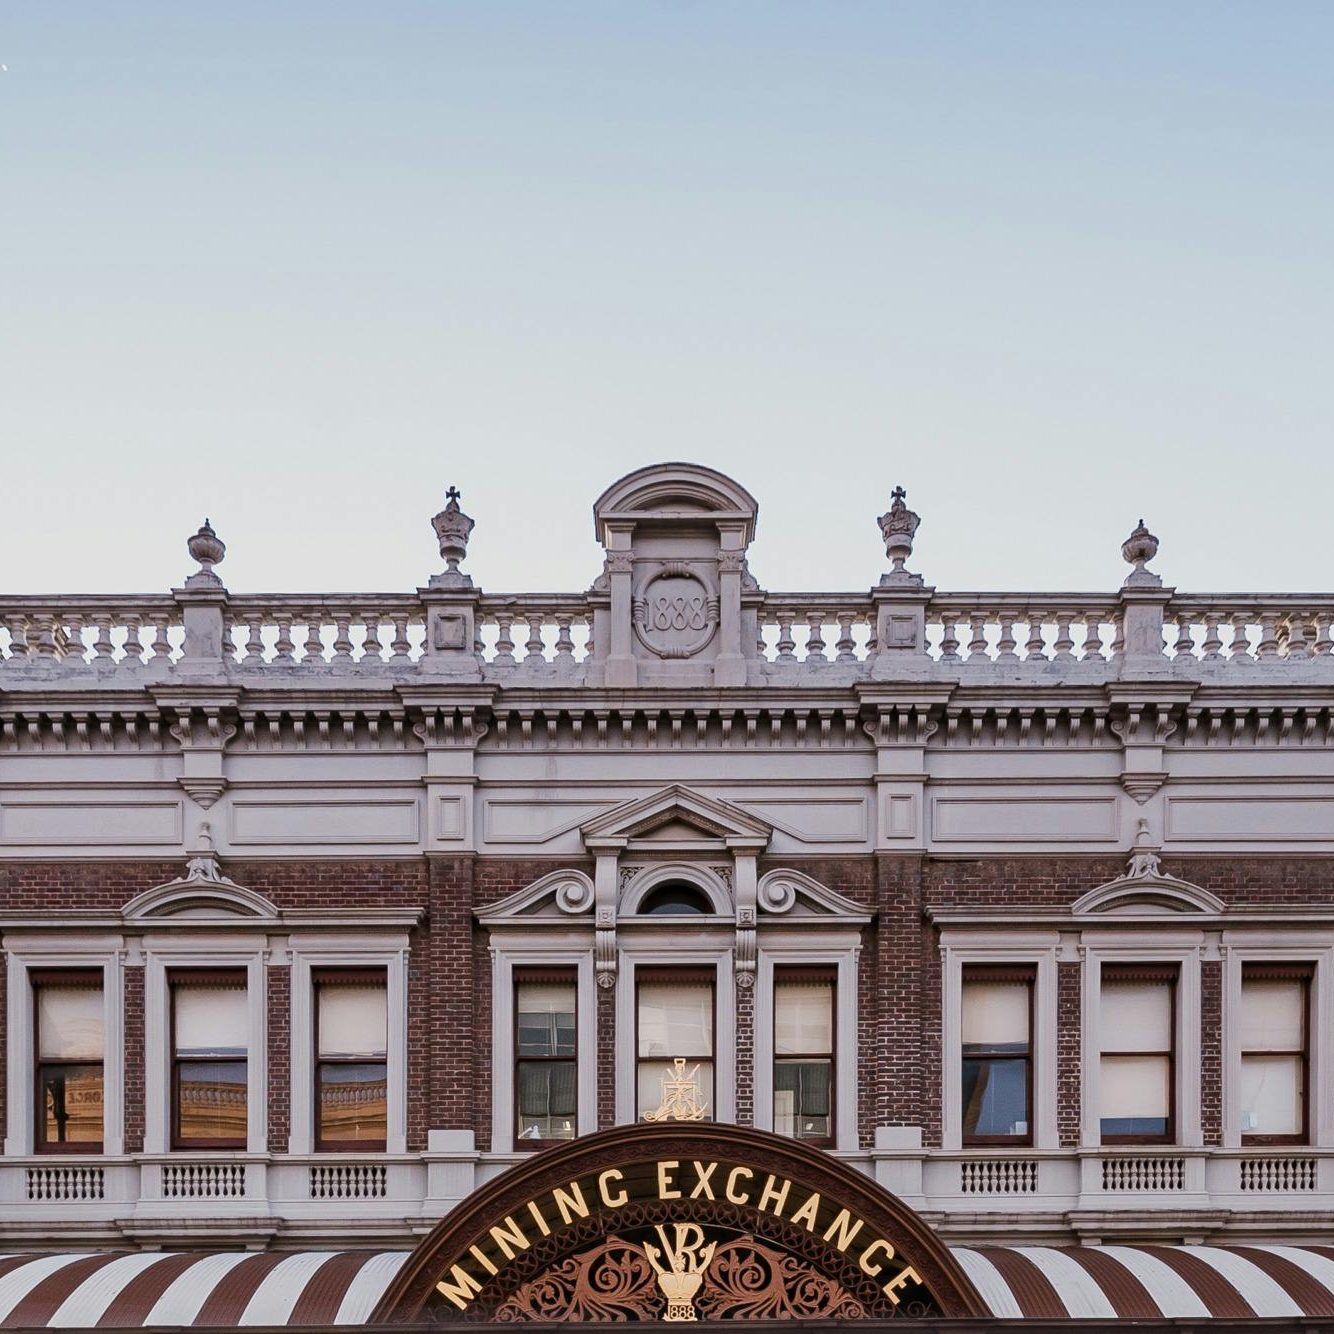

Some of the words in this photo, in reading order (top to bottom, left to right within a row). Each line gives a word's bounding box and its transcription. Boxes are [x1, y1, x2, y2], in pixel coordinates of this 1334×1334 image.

[646, 596, 708, 631] 1888
[436, 1167, 621, 1310] MINING
[656, 1160, 923, 1304] EXCHANGE
[667, 1305, 696, 1319] 1888
